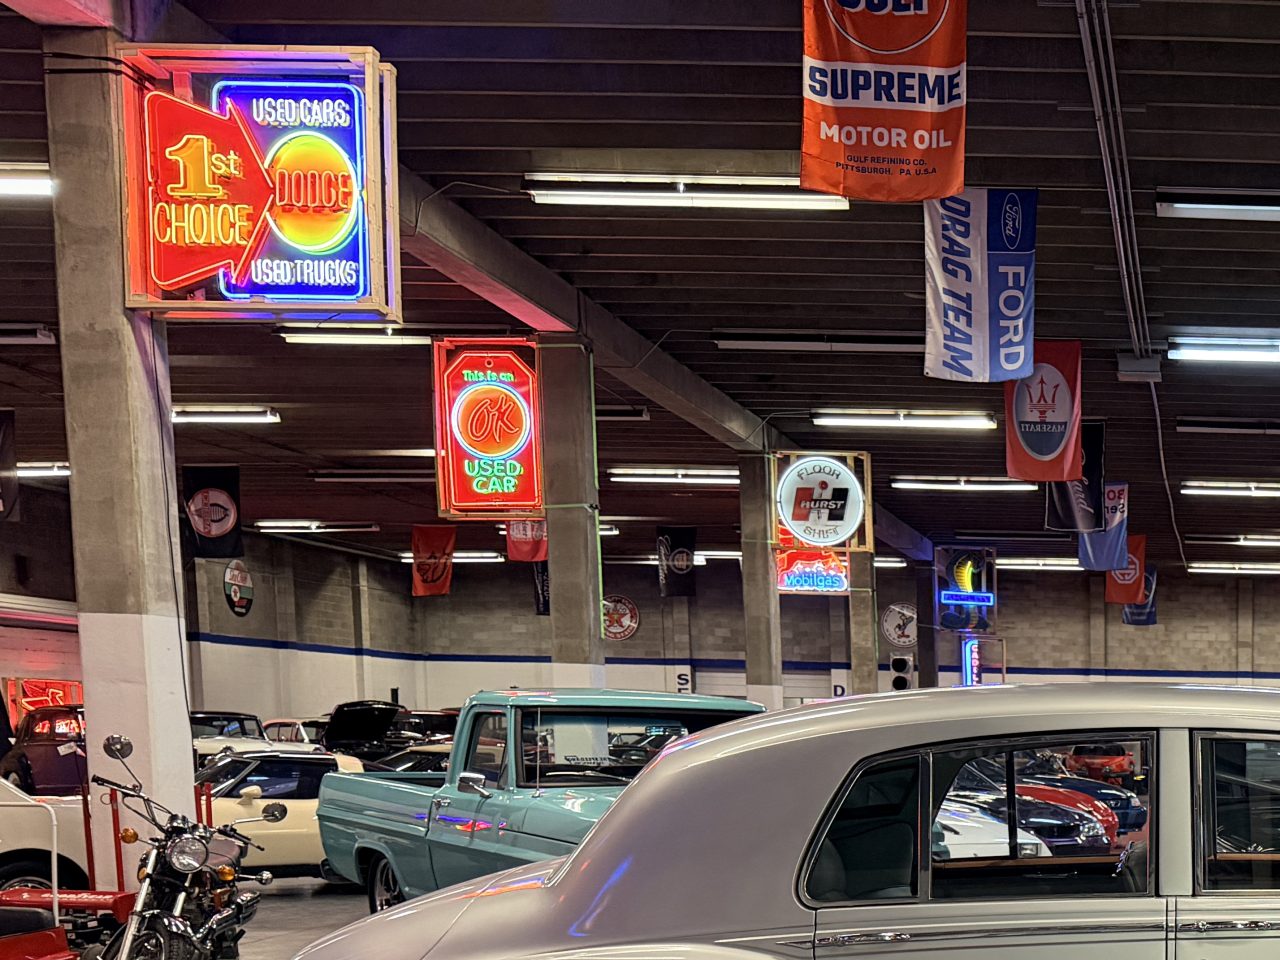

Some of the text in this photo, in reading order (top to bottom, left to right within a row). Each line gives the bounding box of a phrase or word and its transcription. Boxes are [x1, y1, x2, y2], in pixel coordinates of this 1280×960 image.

[808, 66, 962, 105] SUPREME
[252, 97, 350, 125] USED CARS
[820, 121, 952, 149] MOTOR OIL
[165, 134, 241, 197] 1st
[847, 155, 927, 166] GULF REFINING CO.
[275, 169, 350, 209] DODGE
[154, 202, 252, 245] CHOICE
[1005, 204, 1019, 237] Ford
[251, 258, 358, 285] USED TRUCKS
[998, 265, 1025, 371] FORD
[942, 287, 973, 378] TEAM
[468, 394, 519, 442] OK
[465, 459, 522, 476] USED
[797, 464, 841, 480] FLOOR
[473, 478, 517, 493] CAR
[800, 500, 845, 510] HURST
[785, 573, 840, 588] Mobilgas
